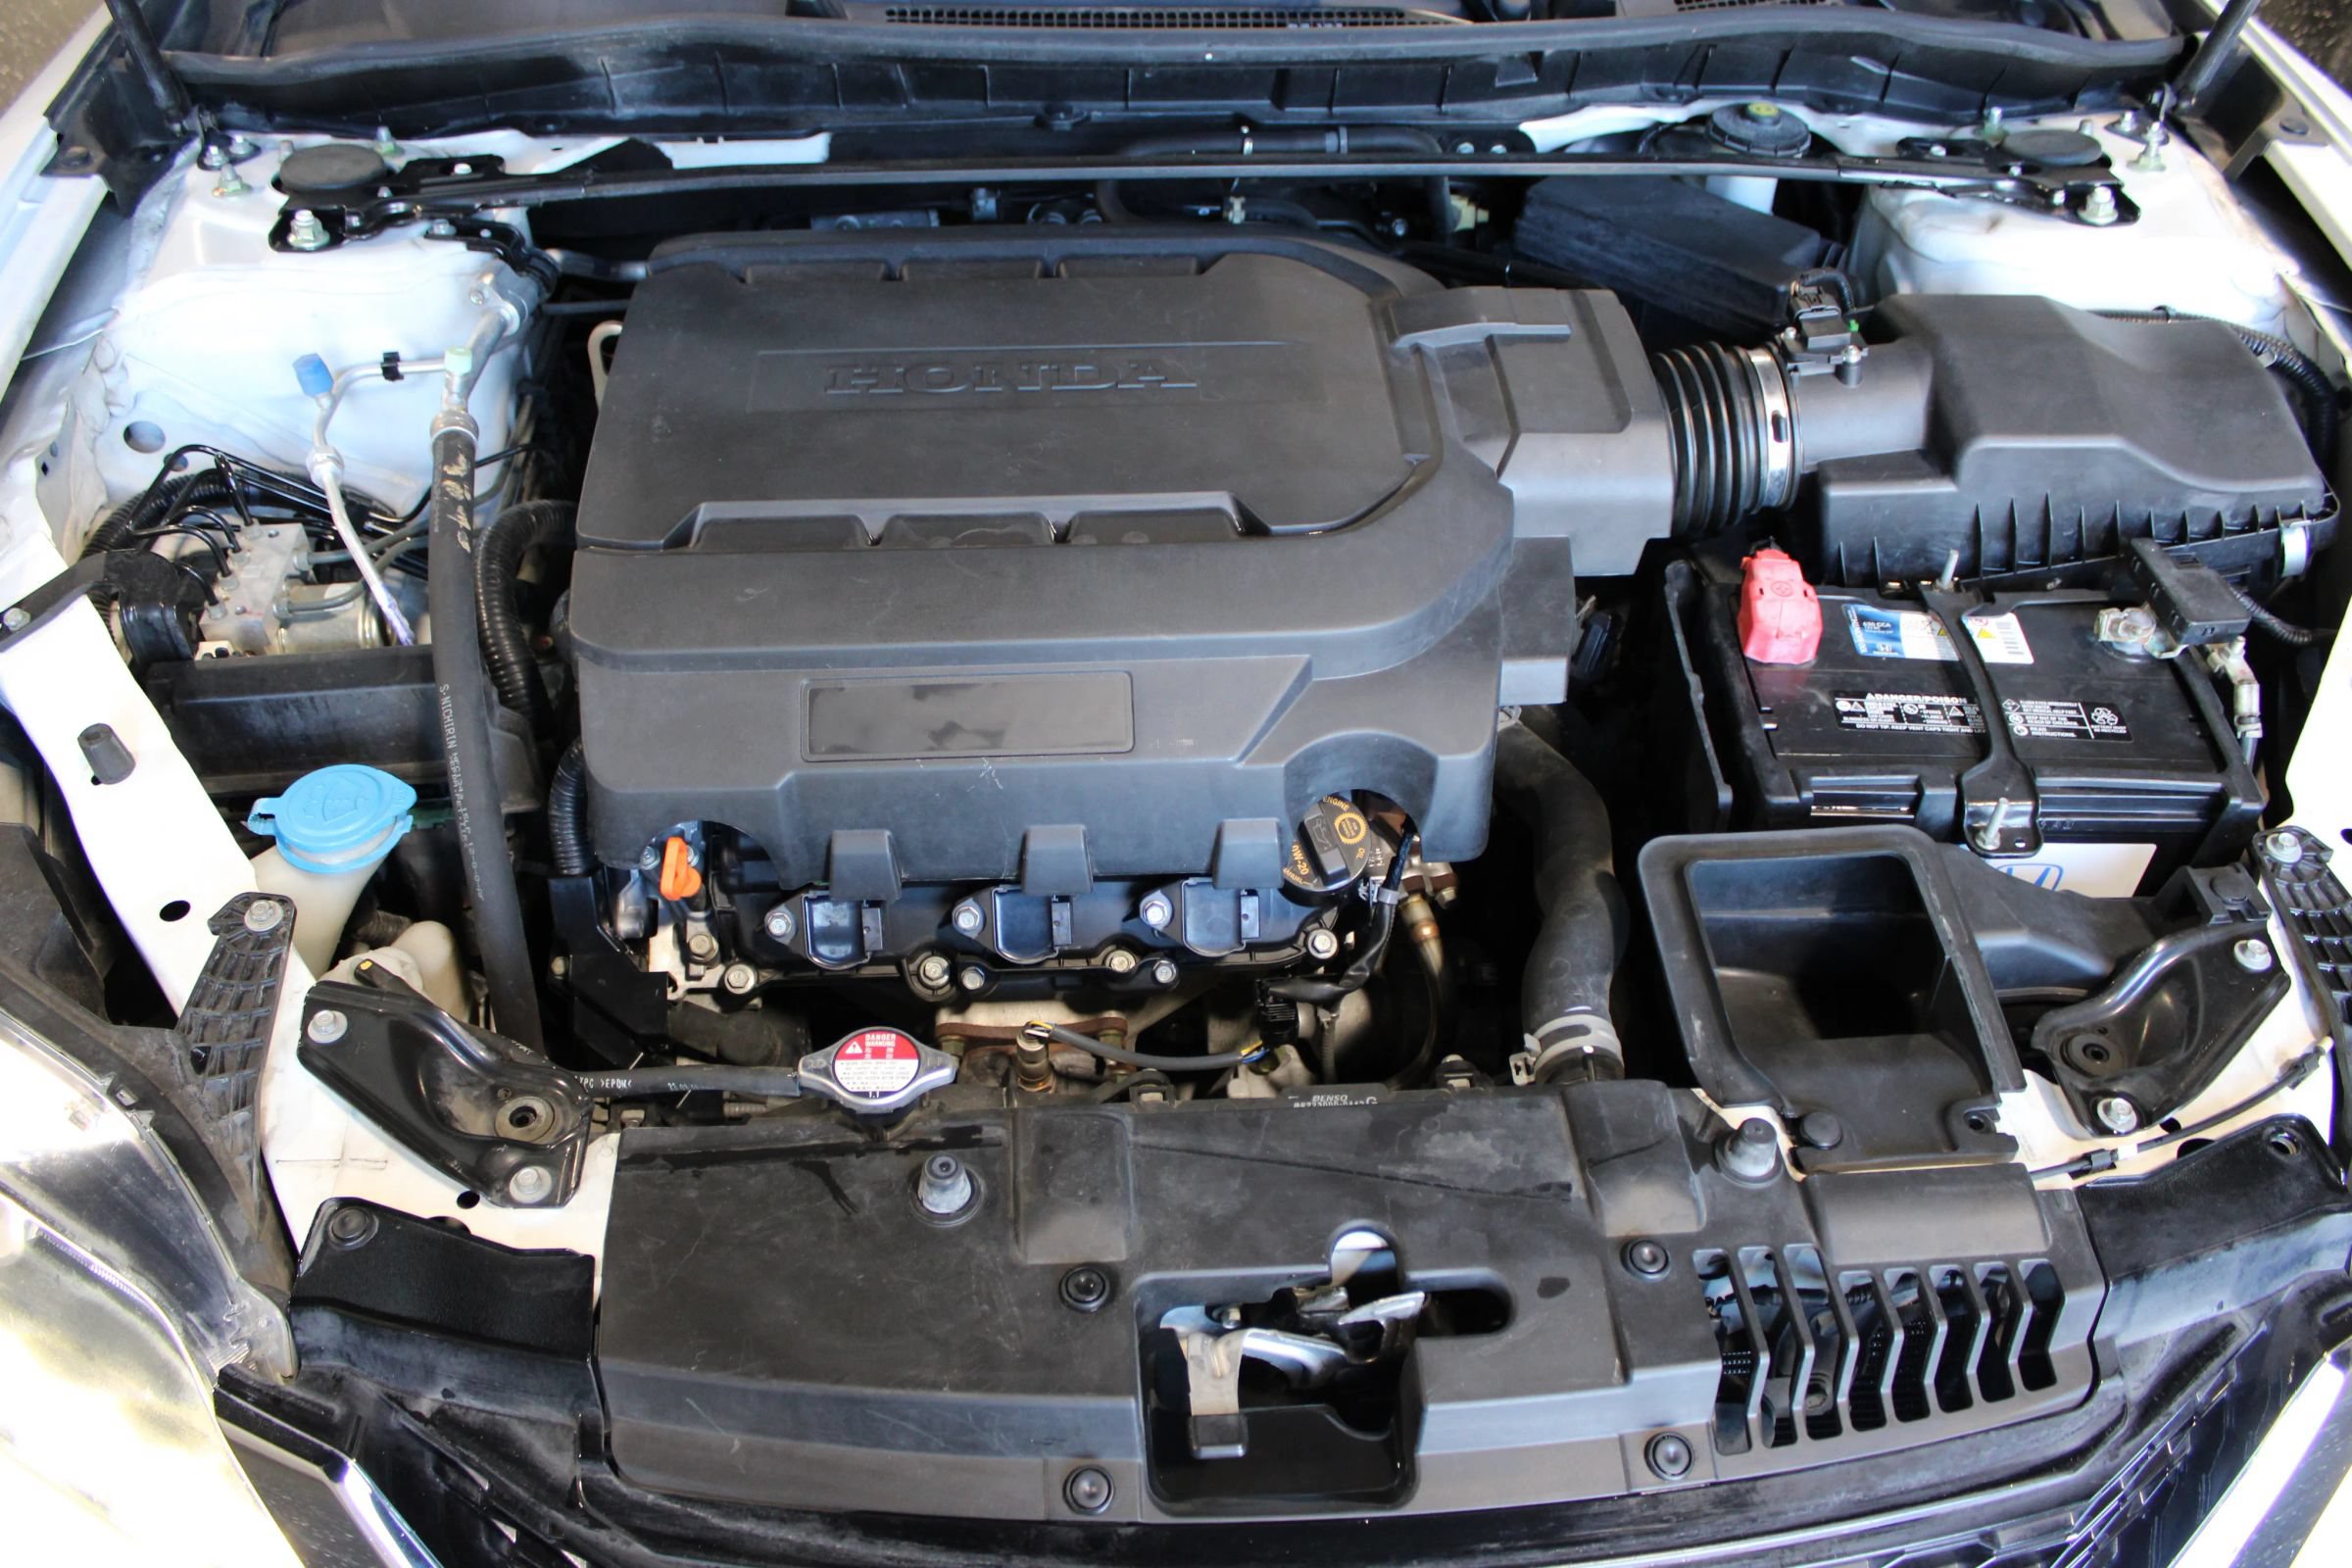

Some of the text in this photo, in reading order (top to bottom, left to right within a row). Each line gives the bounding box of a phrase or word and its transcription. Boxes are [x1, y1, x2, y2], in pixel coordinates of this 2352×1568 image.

[826, 360, 1197, 395] HONDA
[1323, 796, 1365, 859] ENGINE OIL
[1311, 1094, 1348, 1102] DENSO
